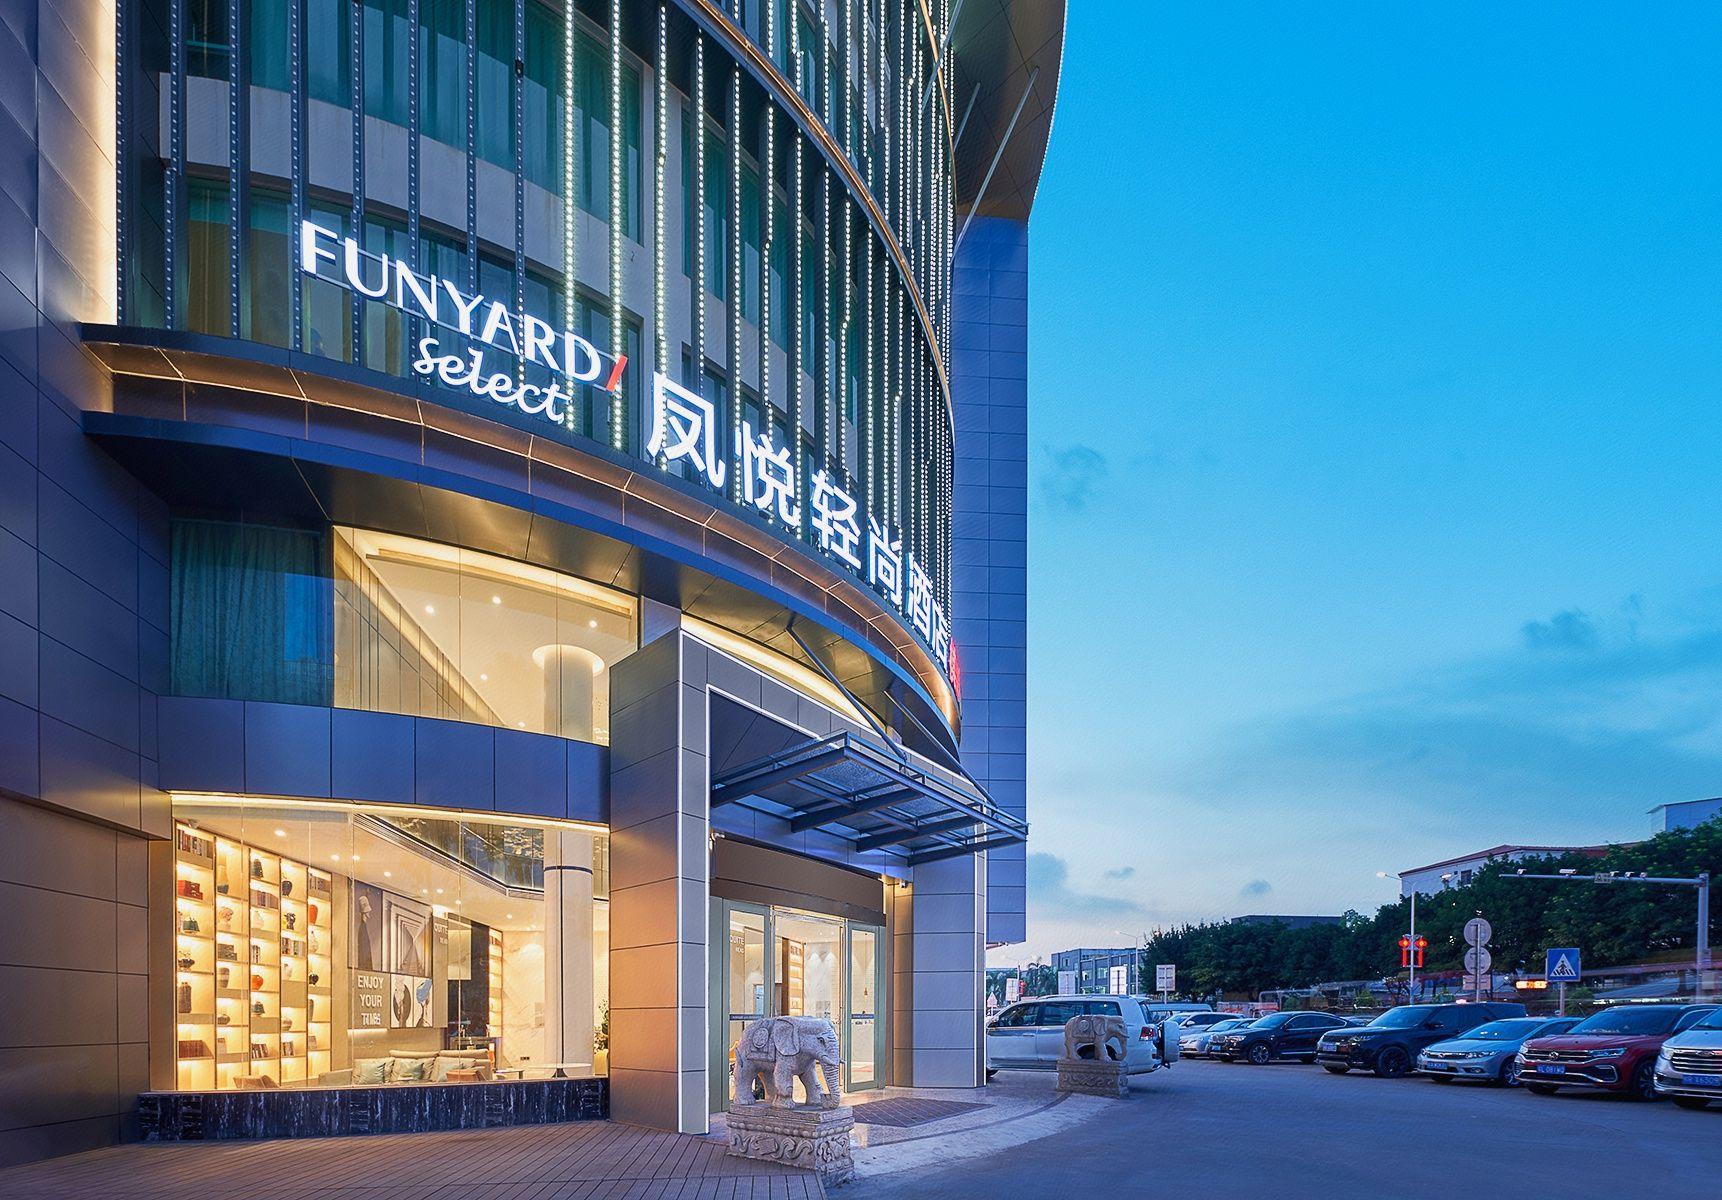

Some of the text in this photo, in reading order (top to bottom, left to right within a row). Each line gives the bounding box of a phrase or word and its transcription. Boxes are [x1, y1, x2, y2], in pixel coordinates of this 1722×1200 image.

[300, 219, 604, 387] FUNYARD
[413, 336, 571, 425] select
[646, 371, 951, 671] 凤悦轻尚酒店
[357, 974, 384, 990] ENJOY
[359, 993, 383, 1009] YOUR
